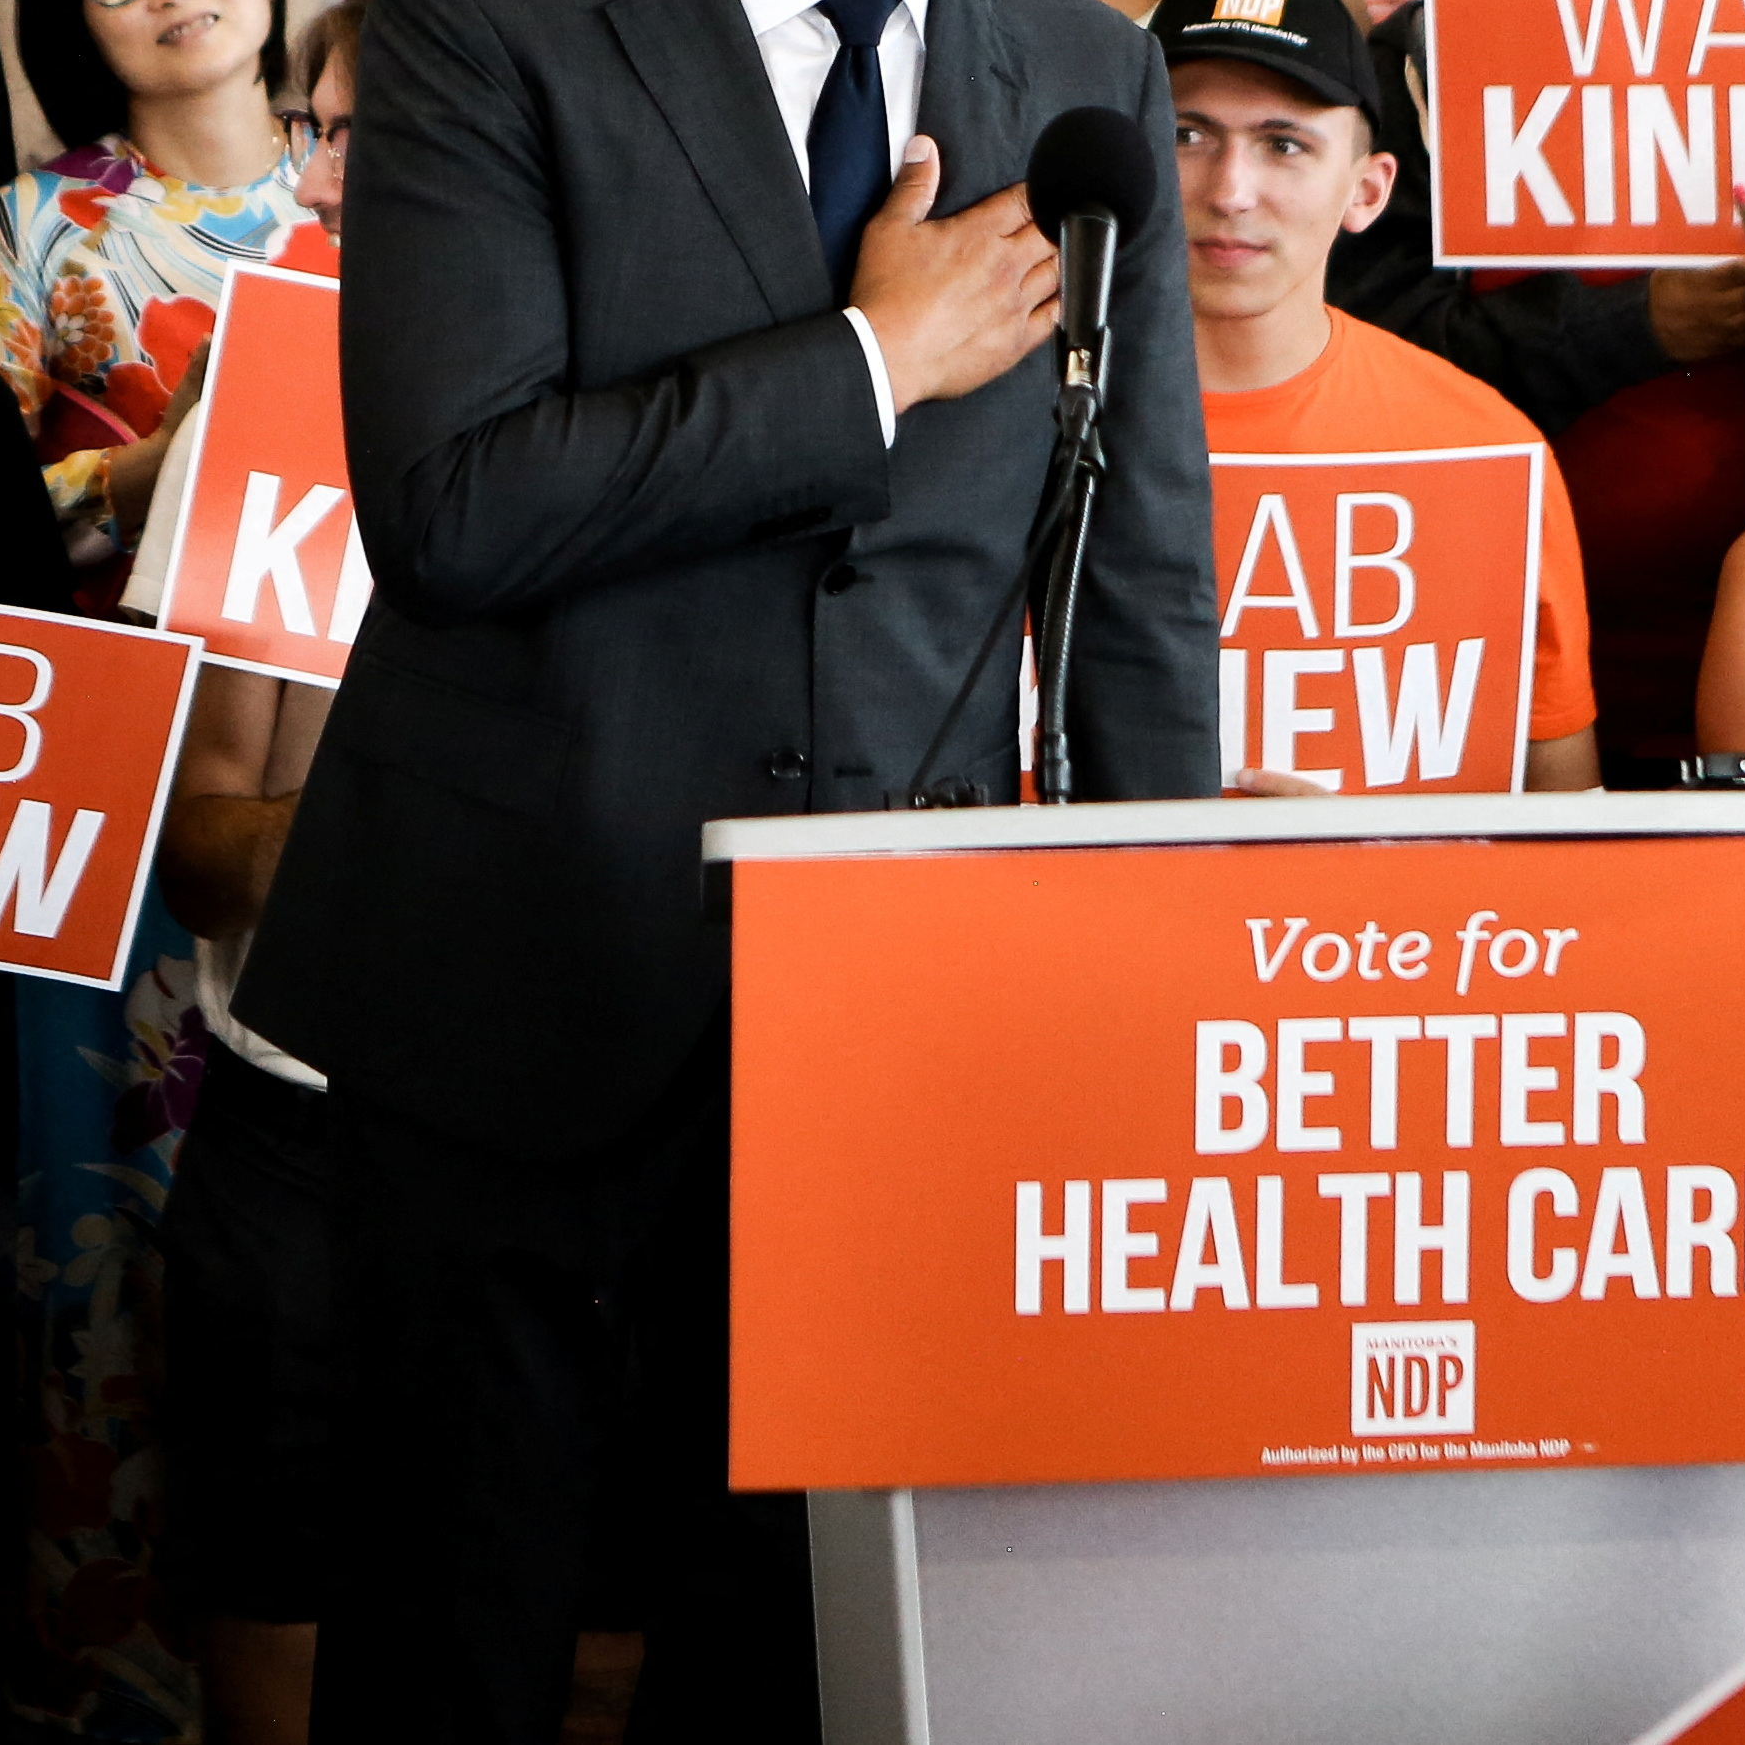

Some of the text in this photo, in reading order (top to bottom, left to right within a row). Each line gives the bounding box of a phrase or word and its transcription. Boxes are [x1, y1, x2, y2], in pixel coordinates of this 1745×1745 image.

[1220, 491, 1416, 639] AB
[1245, 911, 1579, 996] Vote for
[1195, 1012, 1645, 1154] BETTER
[1016, 1171, 1470, 1315] HEALTH
[1366, 1353, 1464, 1421] NDP
[1261, 1445, 1340, 1465] Authorized
[1341, 1444, 1359, 1465] by
[1362, 1443, 1385, 1462] the
[1388, 1442, 1417, 1462] CFO
[1420, 1442, 1440, 1461] for
[1444, 1441, 1467, 1460] the
[1470, 1439, 1536, 1460] Manitoba
[1539, 1438, 1571, 1458] NDP
